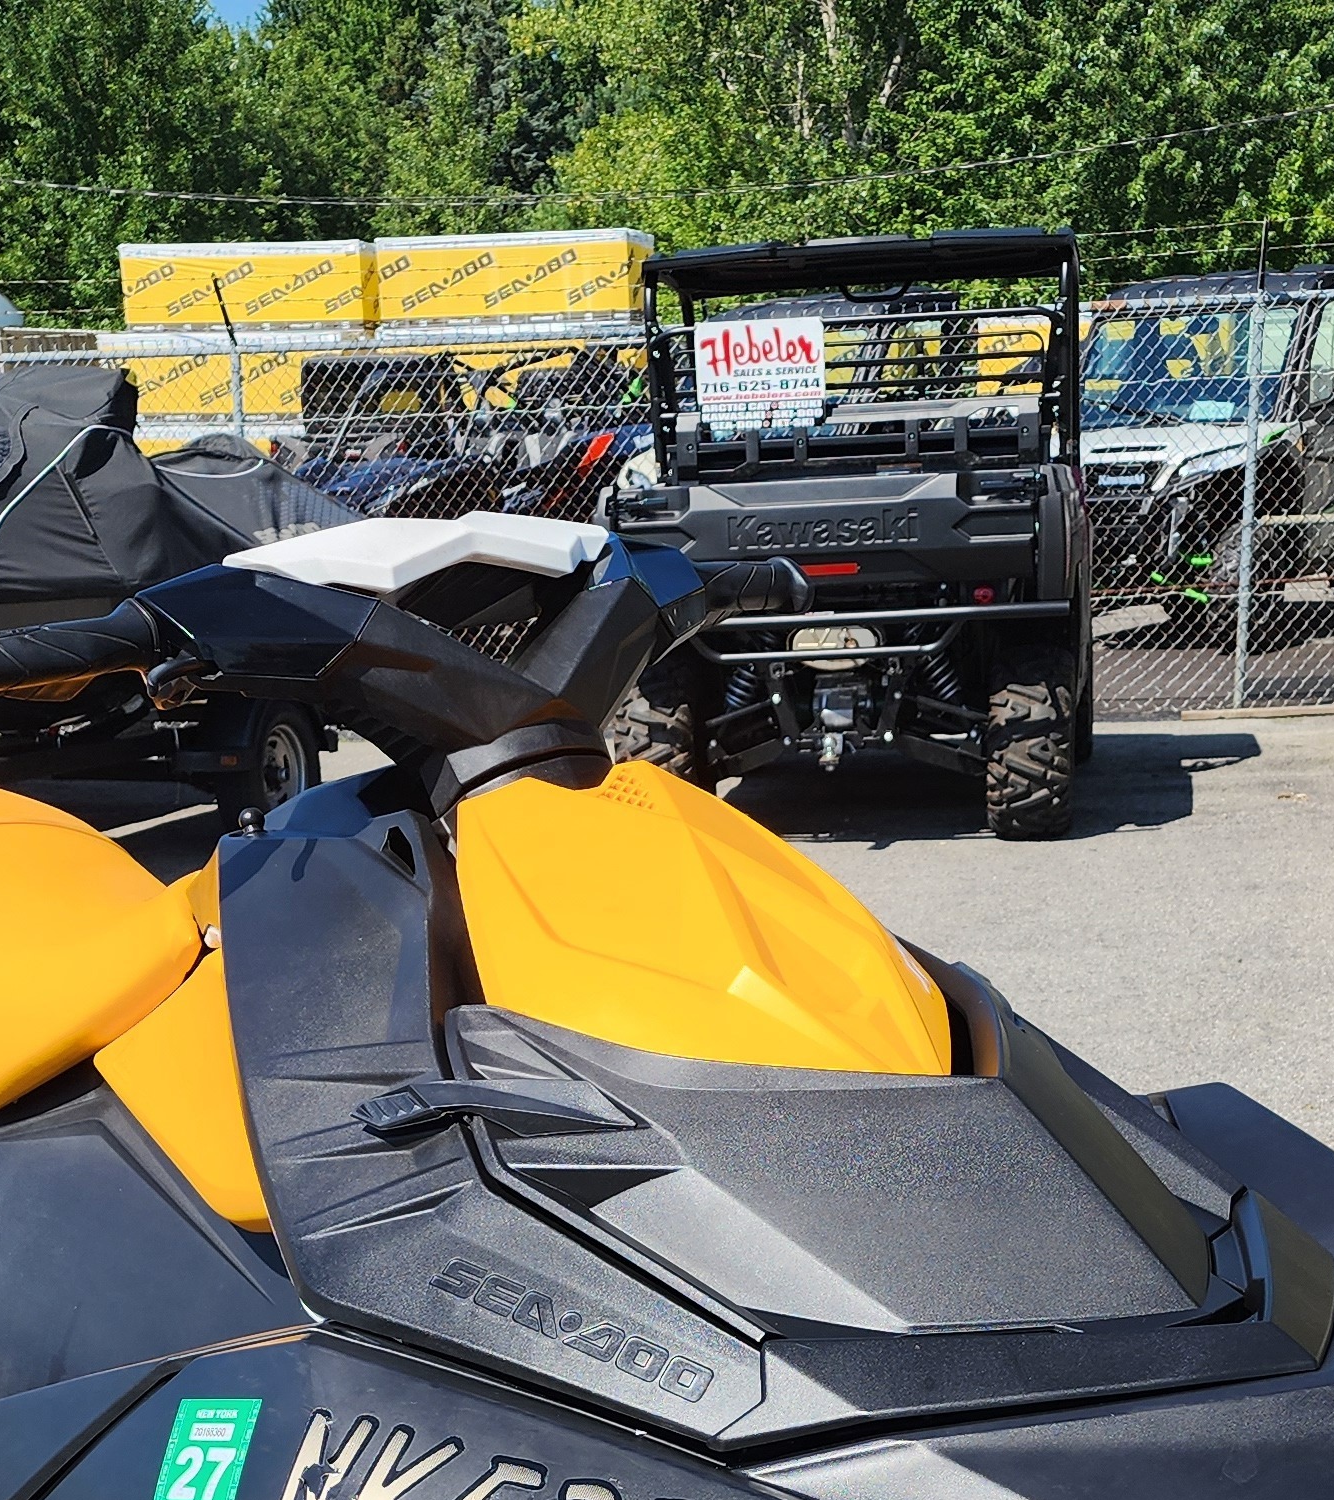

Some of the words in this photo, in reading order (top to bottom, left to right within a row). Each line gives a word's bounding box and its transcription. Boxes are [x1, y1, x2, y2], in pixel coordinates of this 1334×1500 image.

[700, 325, 821, 377] Hebeler
[733, 367, 764, 378] SALES
[765, 368, 772, 376] &
[775, 365, 818, 375] SERVICE
[700, 378, 821, 394] 716-625-8744
[702, 390, 822, 402] www.hebelers.com
[727, 506, 919, 550] Kawasaki
